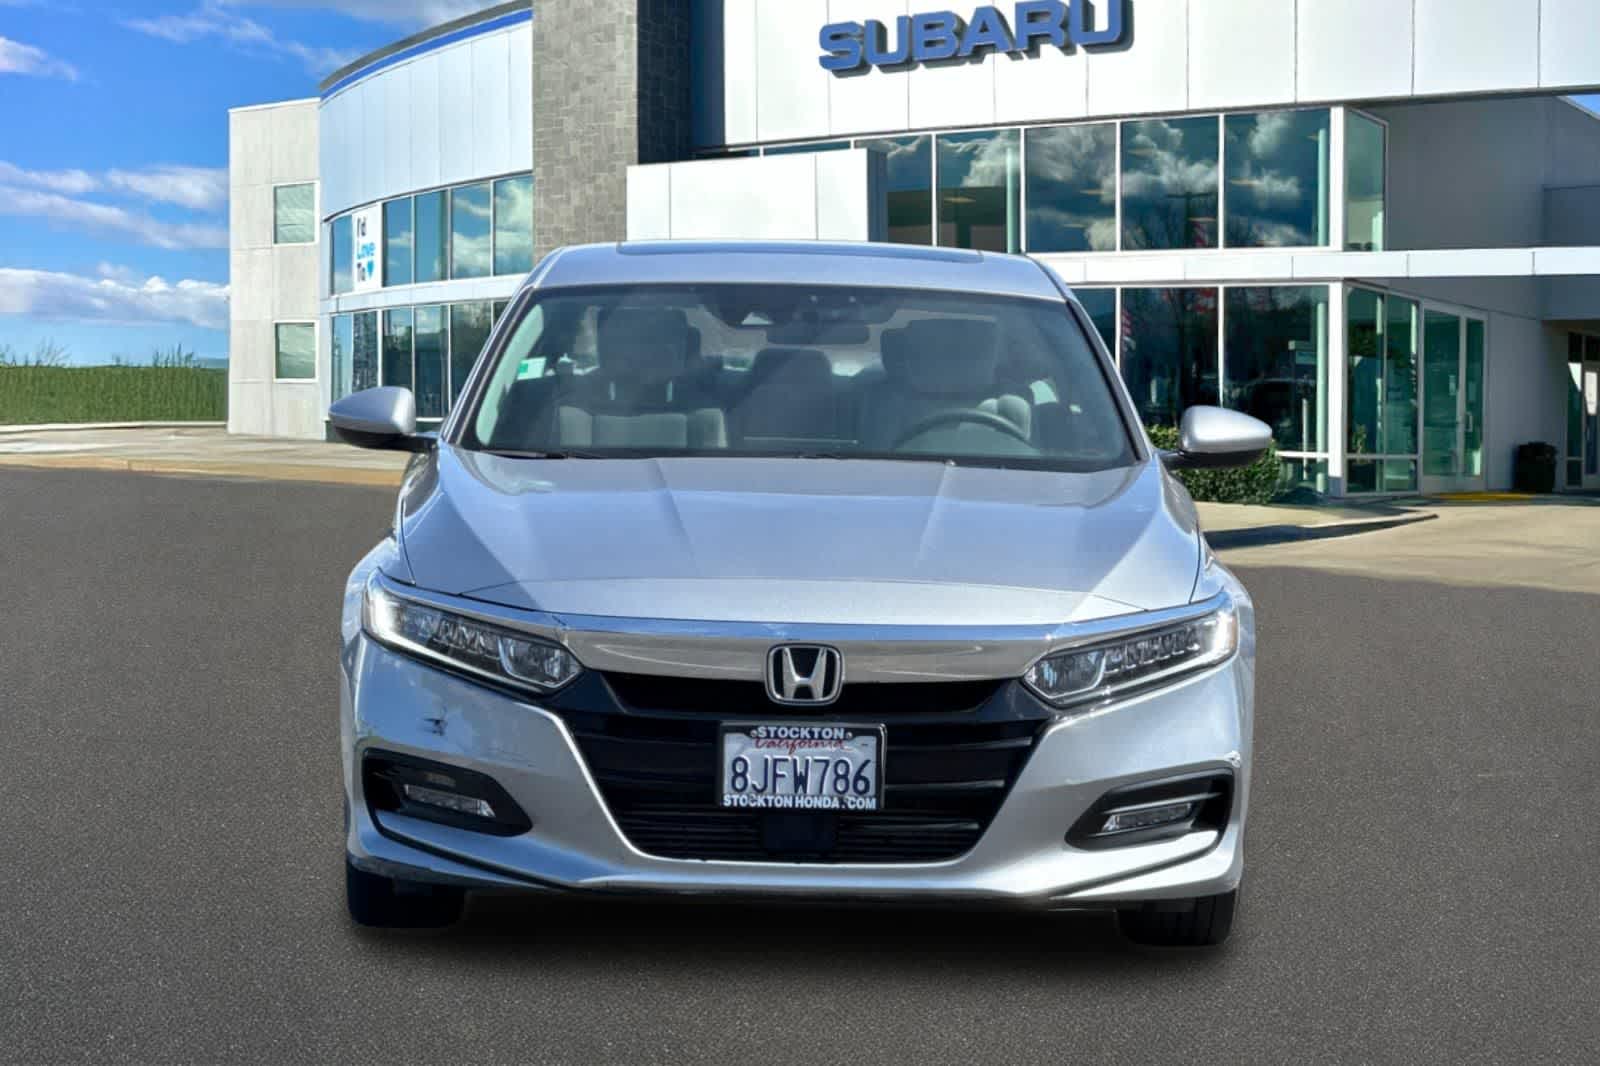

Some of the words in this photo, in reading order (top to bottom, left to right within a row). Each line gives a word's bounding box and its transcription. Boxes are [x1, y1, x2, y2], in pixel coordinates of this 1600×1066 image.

[819, 0, 1128, 74] SUBARU
[757, 726, 845, 739] STOCKTON
[731, 755, 871, 796] 8JFW786
